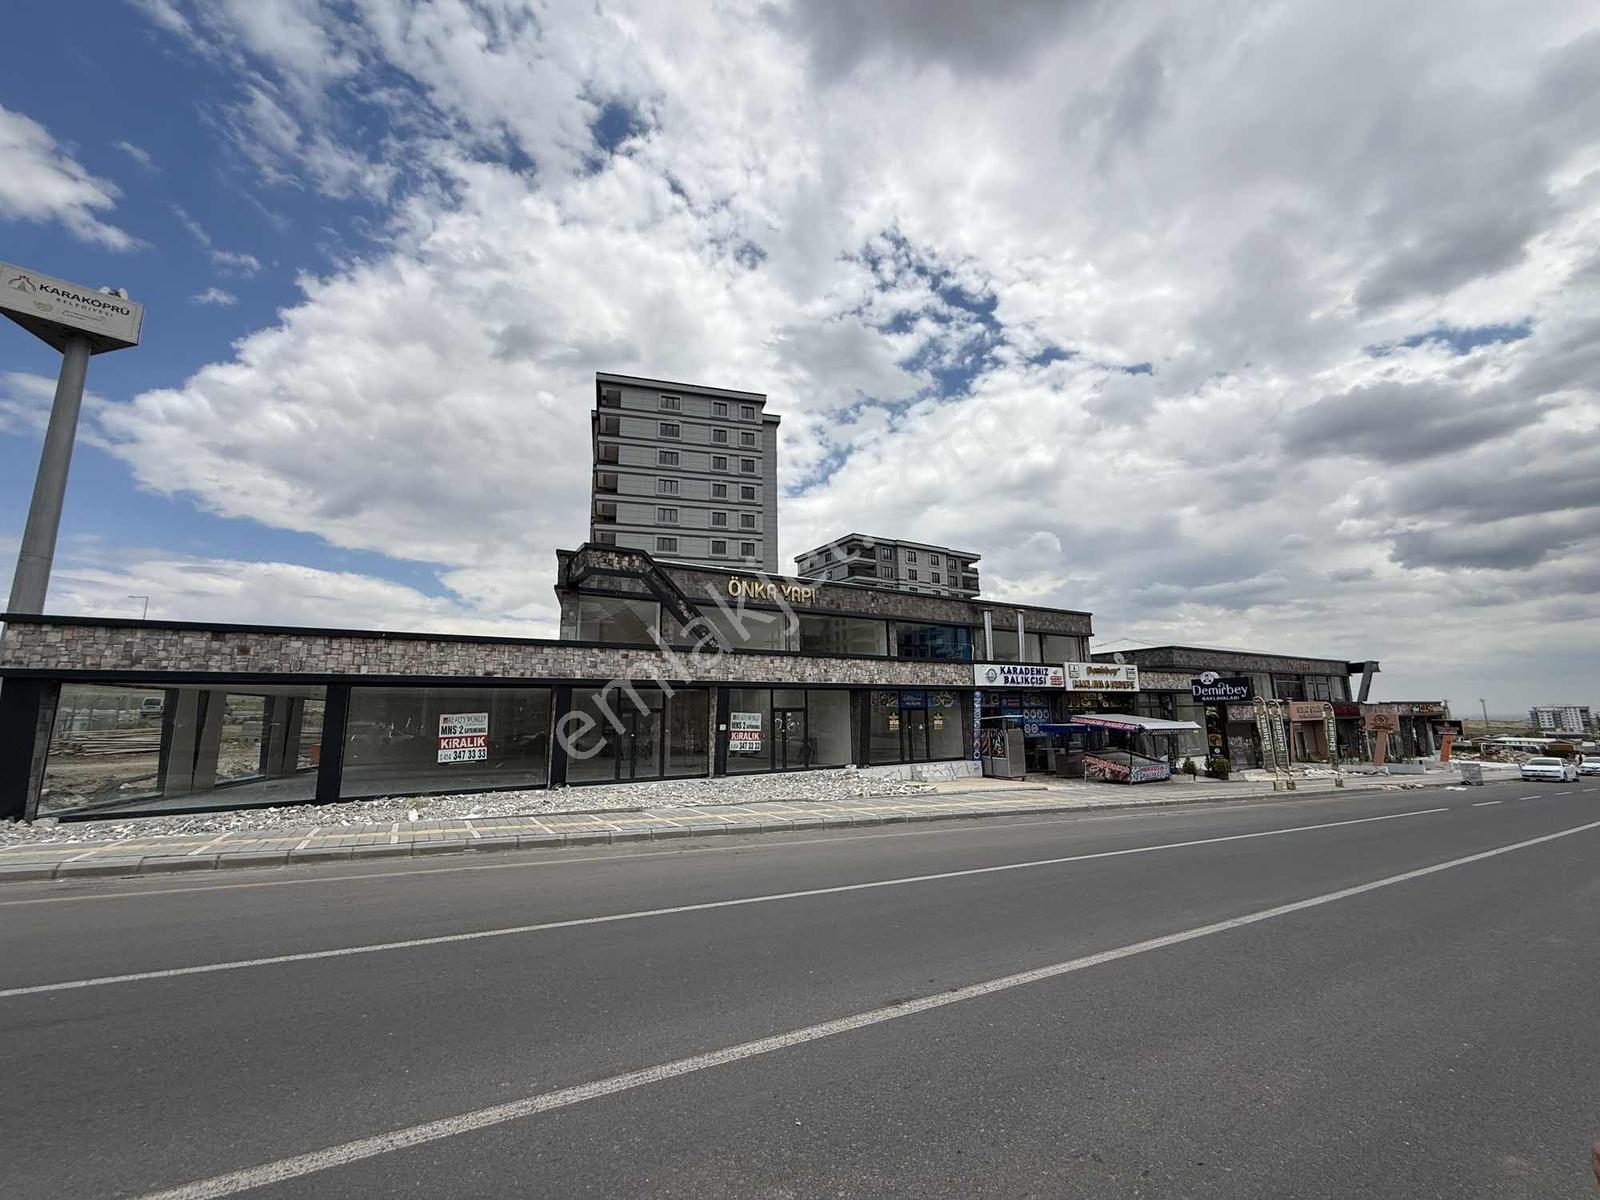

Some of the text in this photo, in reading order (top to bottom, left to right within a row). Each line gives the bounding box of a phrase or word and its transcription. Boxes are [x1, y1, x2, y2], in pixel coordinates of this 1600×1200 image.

[39, 284, 130, 316] KARAKÖPRÜ
[728, 576, 816, 604] ÖNKA YAPI
[1192, 682, 1248, 698] Demirbey
[441, 725, 457, 735] MNS
[459, 725, 464, 734] 2
[453, 750, 466, 760] 347
[467, 749, 476, 759] 33
[478, 749, 486, 758] 33
